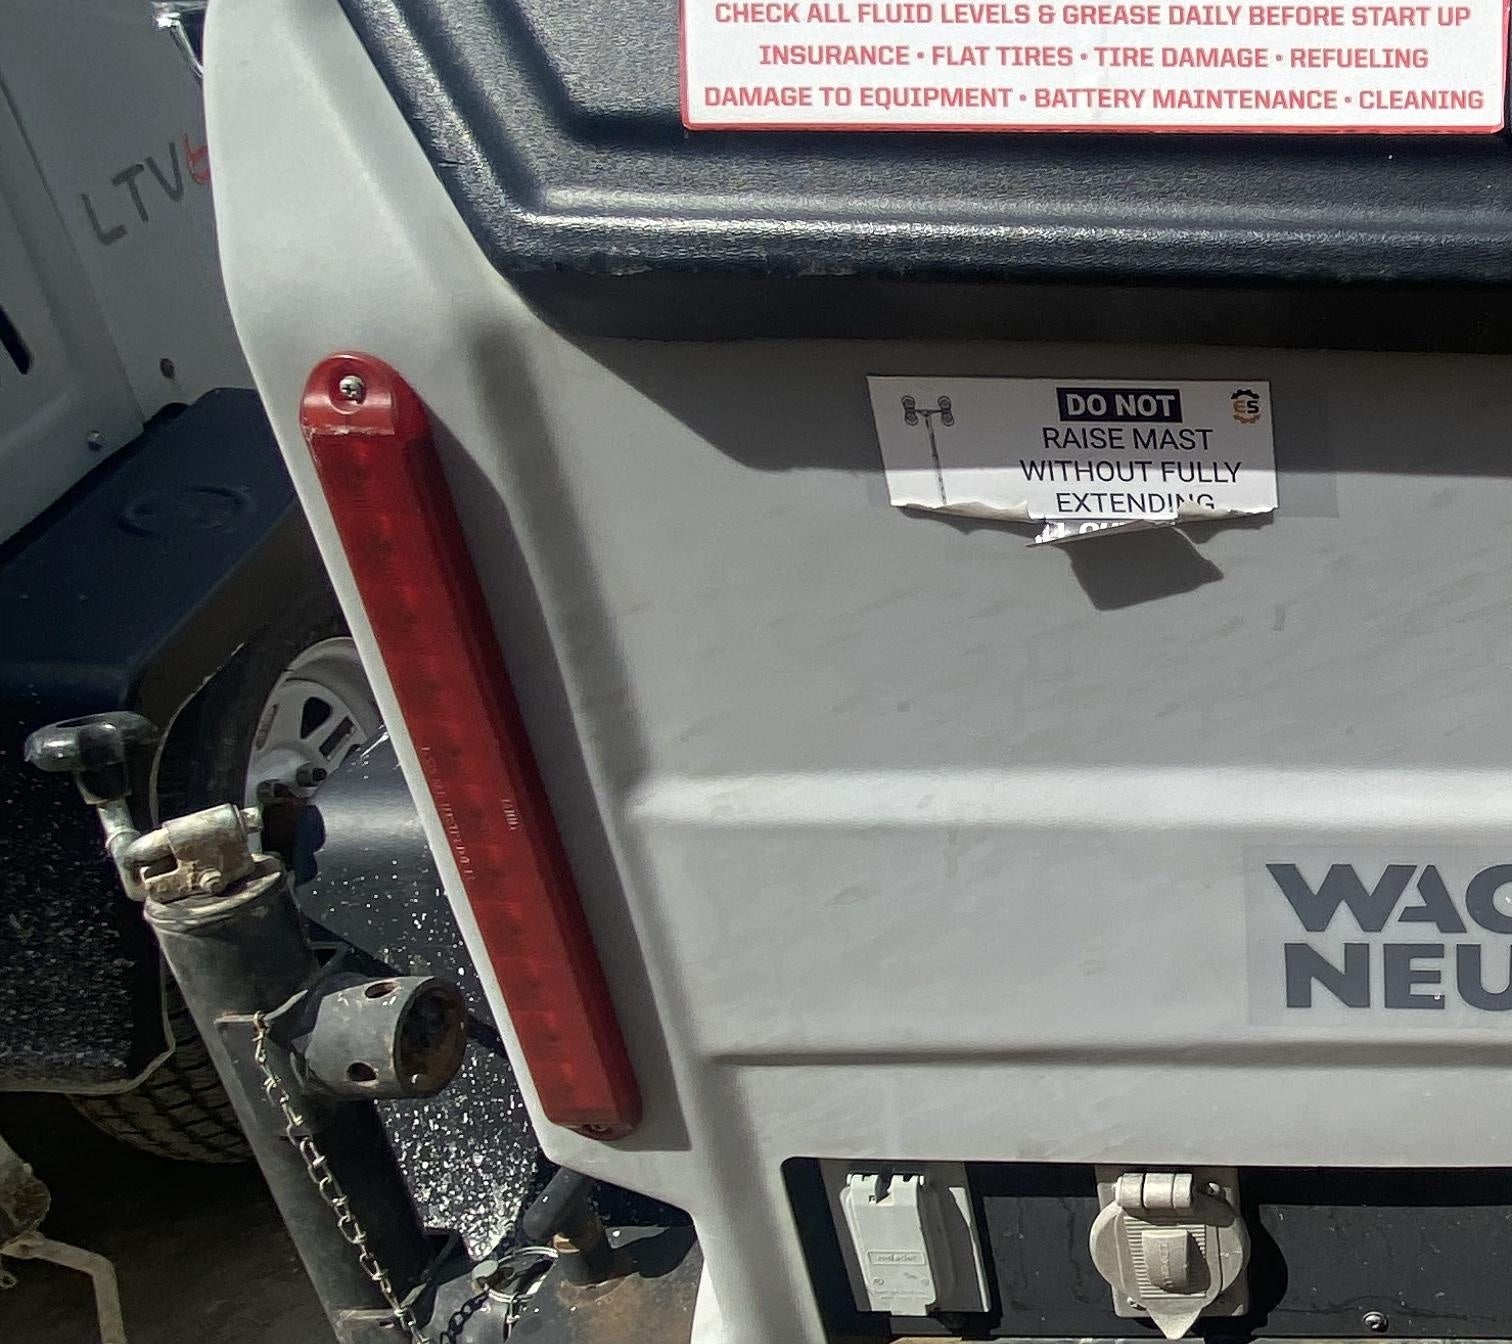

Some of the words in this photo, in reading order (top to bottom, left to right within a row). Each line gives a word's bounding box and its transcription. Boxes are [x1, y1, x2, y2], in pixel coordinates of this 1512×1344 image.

[715, 2, 799, 24] CHECK
[807, 2, 850, 24] ALL
[858, 3, 933, 24] FLUID
[941, 3, 1031, 25] LEVELS
[1038, 4, 1055, 25] &
[1062, 4, 1161, 26] GREASE
[1169, 4, 1242, 26] DAILY
[1249, 5, 1345, 26] BEFORE
[1352, 6, 1431, 26] START
[1437, 6, 1471, 27] UP
[759, 44, 909, 66] INSURANCE
[932, 45, 987, 66] FLAT
[994, 46, 1073, 67] TIRES
[1093, 46, 1154, 67] TIRE
[1161, 47, 1268, 68] DAMAGE
[1290, 48, 1429, 68] REFUELING
[704, 86, 812, 107] DAMAGE
[819, 87, 852, 107] TO
[860, 87, 1014, 110] EQUIPMENT
[1034, 88, 1146, 109] BATTERY
[1152, 89, 1338, 110] MAINTENANCE
[1359, 90, 1484, 110] CLEANING
[1066, 393, 1108, 417] DO
[1115, 394, 1176, 418] NOT
[1043, 427, 1124, 451] RAISE
[1132, 428, 1214, 452] MAST
[1019, 459, 1153, 484] WITHOUT
[1161, 461, 1242, 484] FULLY
